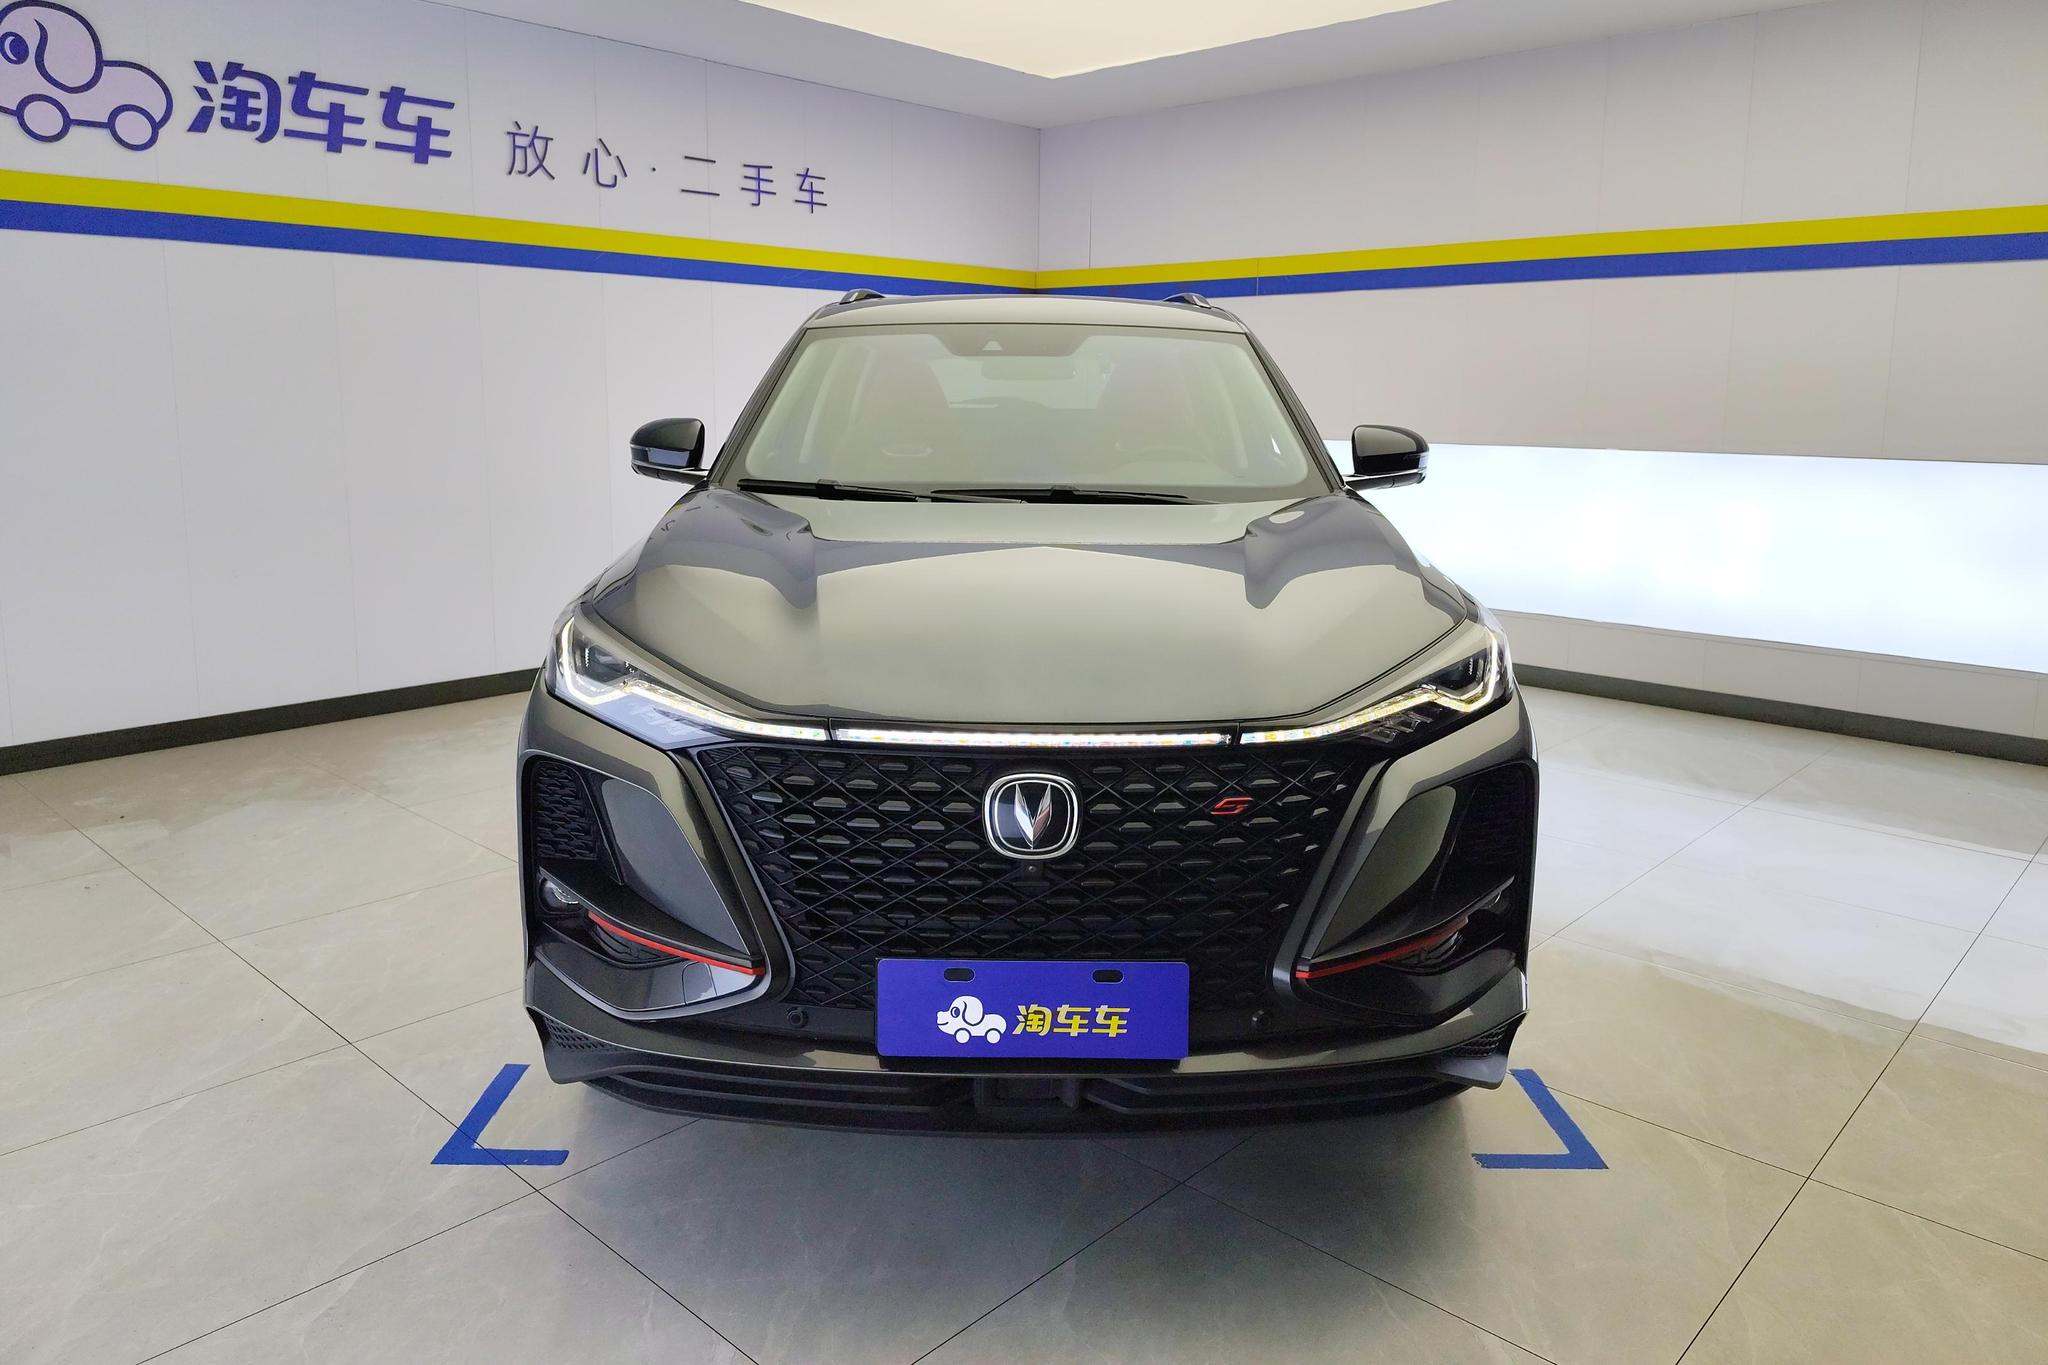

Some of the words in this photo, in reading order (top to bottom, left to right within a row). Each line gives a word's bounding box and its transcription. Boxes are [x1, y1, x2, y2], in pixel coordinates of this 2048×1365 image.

[187, 60, 456, 165] 淘车车
[1012, 1004, 1131, 1038] 淘车车
